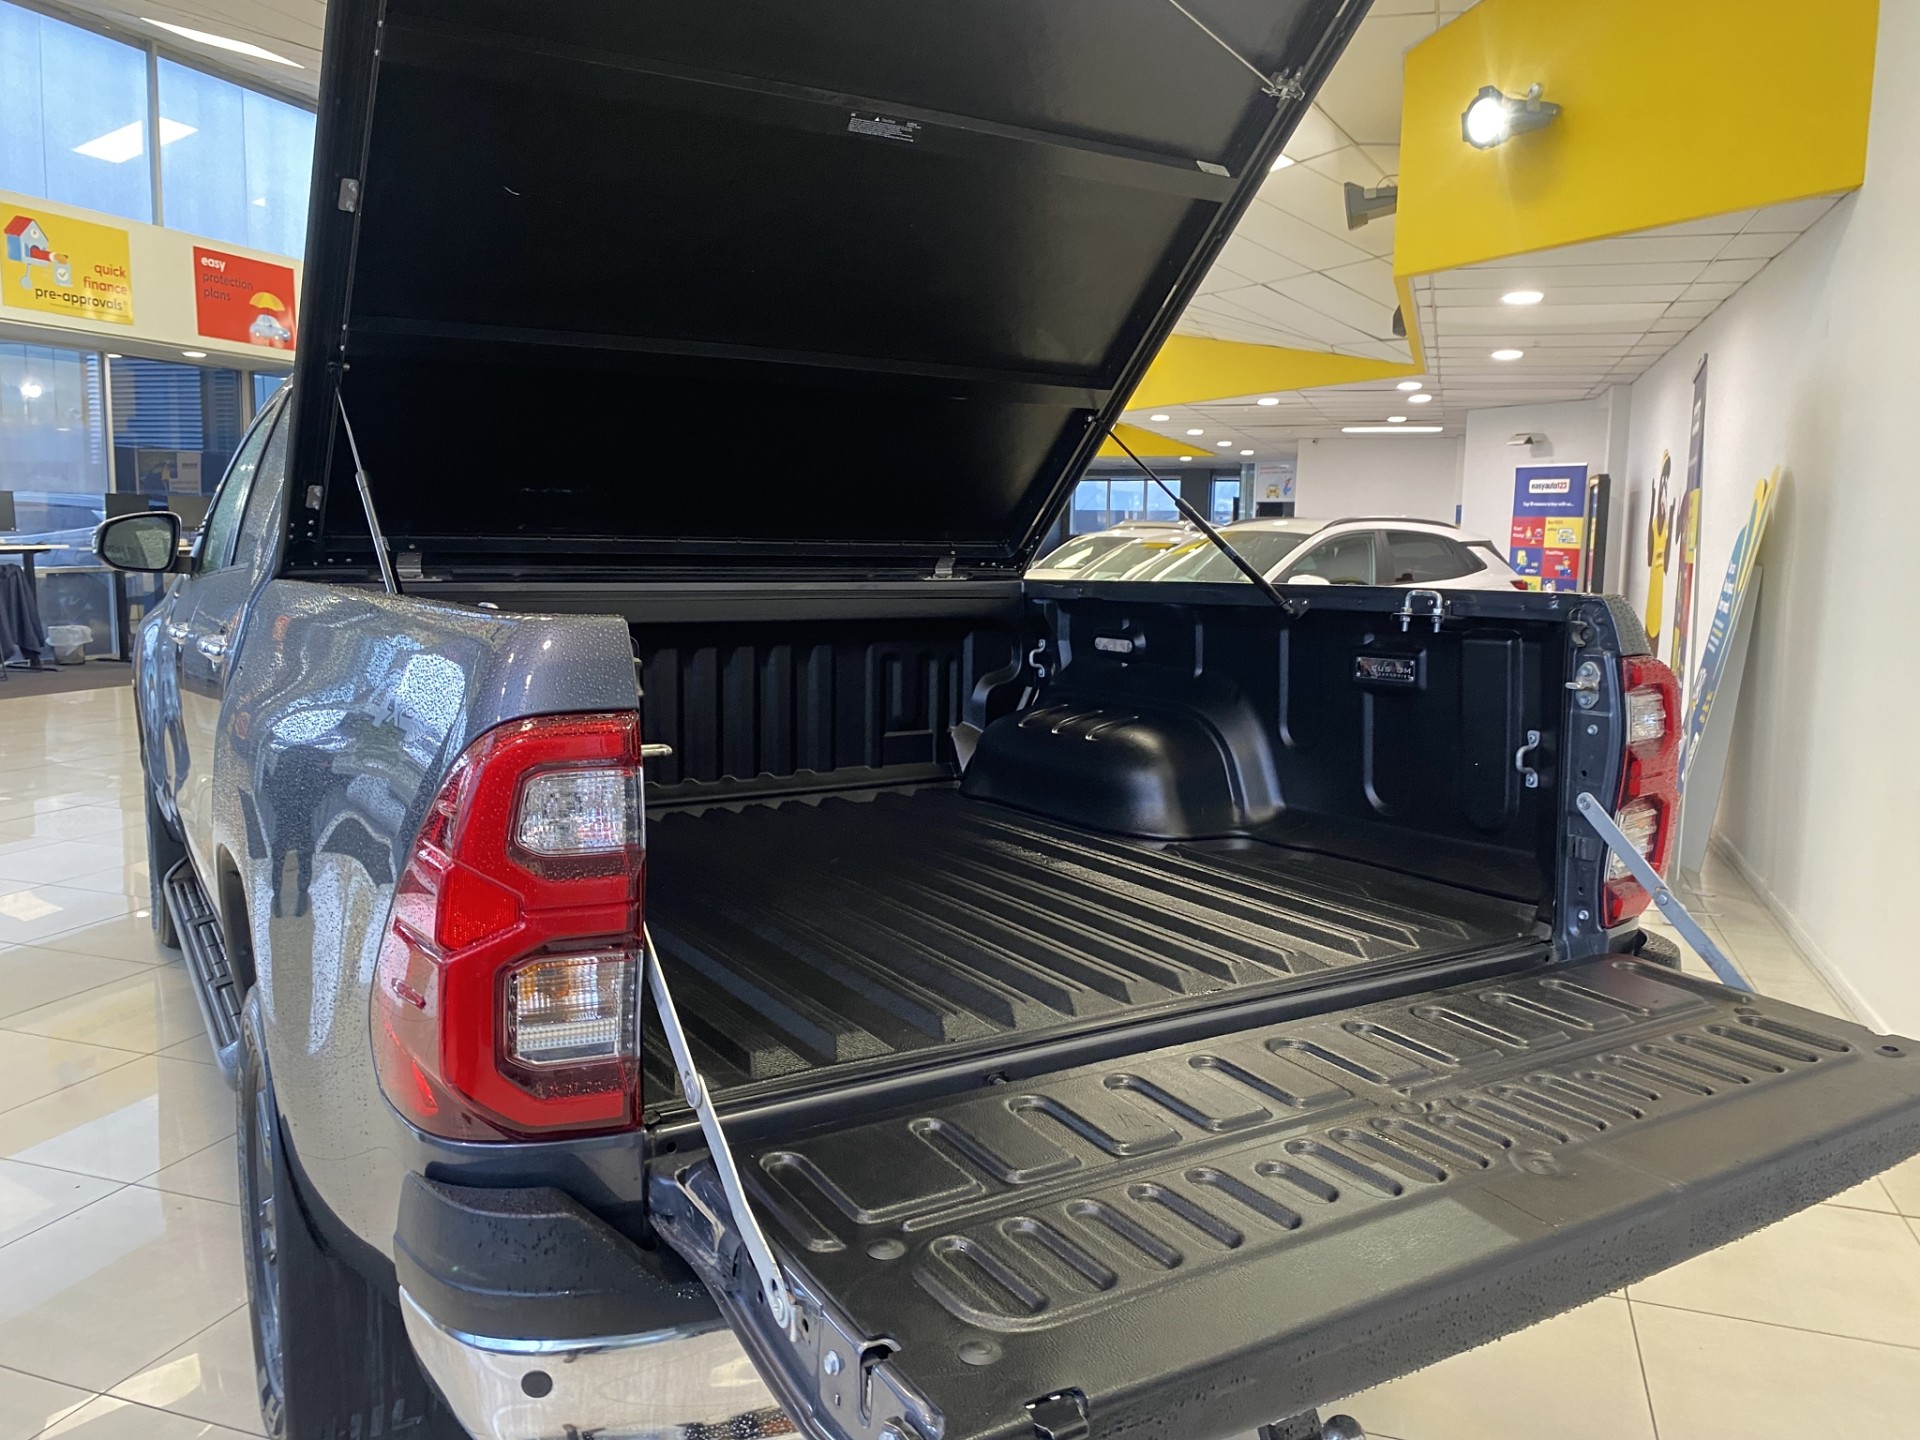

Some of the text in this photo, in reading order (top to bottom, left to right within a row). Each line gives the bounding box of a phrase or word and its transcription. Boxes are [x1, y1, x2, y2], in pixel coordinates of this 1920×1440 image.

[94, 264, 126, 278] quick
[201, 256, 226, 273] easy
[83, 276, 128, 295] finance
[202, 273, 254, 291] protection
[203, 287, 231, 301] plans
[1531, 482, 1567, 491] easyauto123
